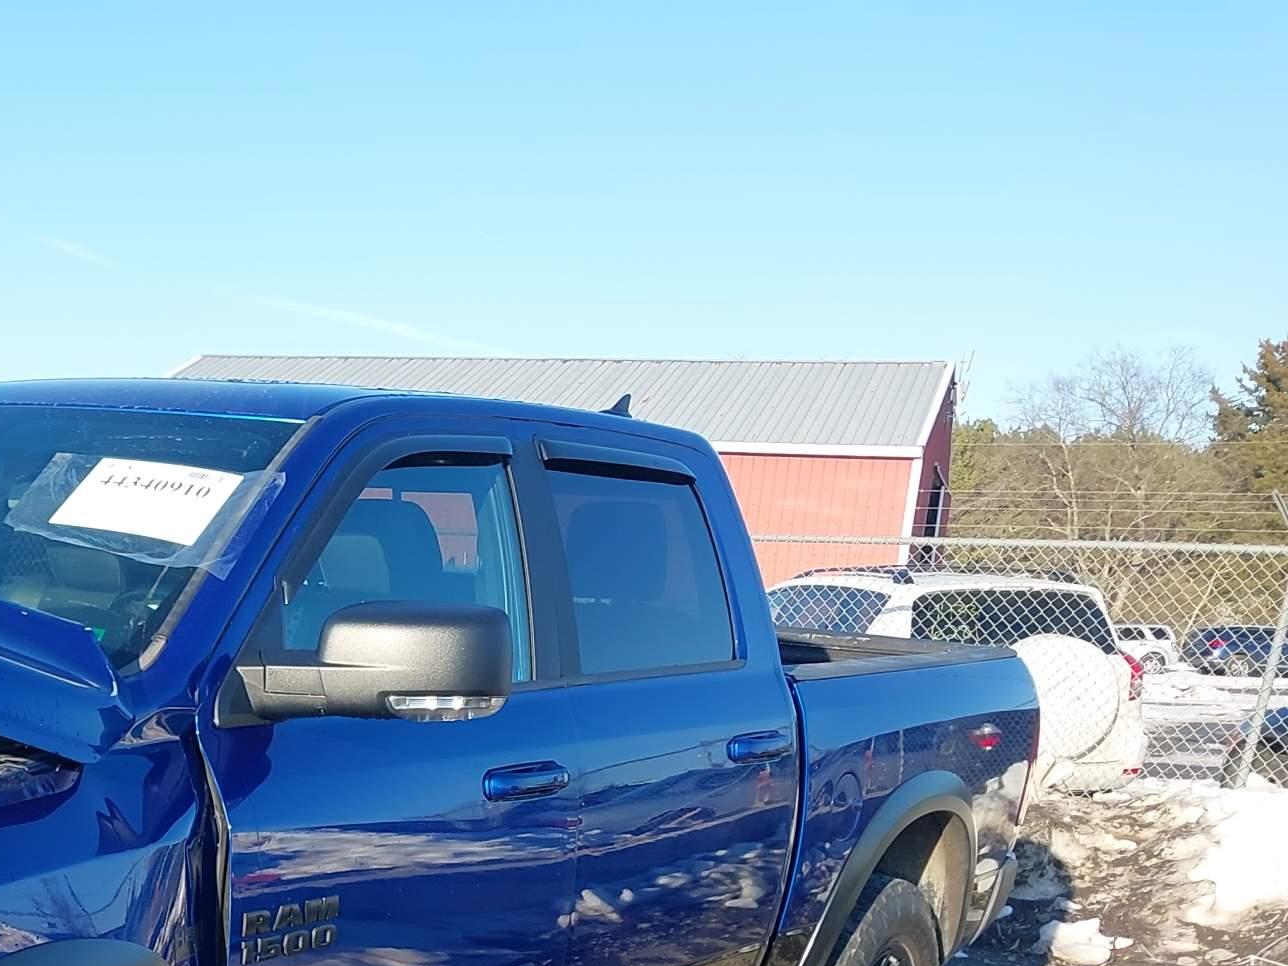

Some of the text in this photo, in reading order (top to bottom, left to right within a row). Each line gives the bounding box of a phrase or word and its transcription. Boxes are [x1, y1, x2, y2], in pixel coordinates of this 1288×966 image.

[99, 474, 212, 498] 44340910
[242, 895, 339, 937] RAM
[241, 924, 337, 966] 1500
